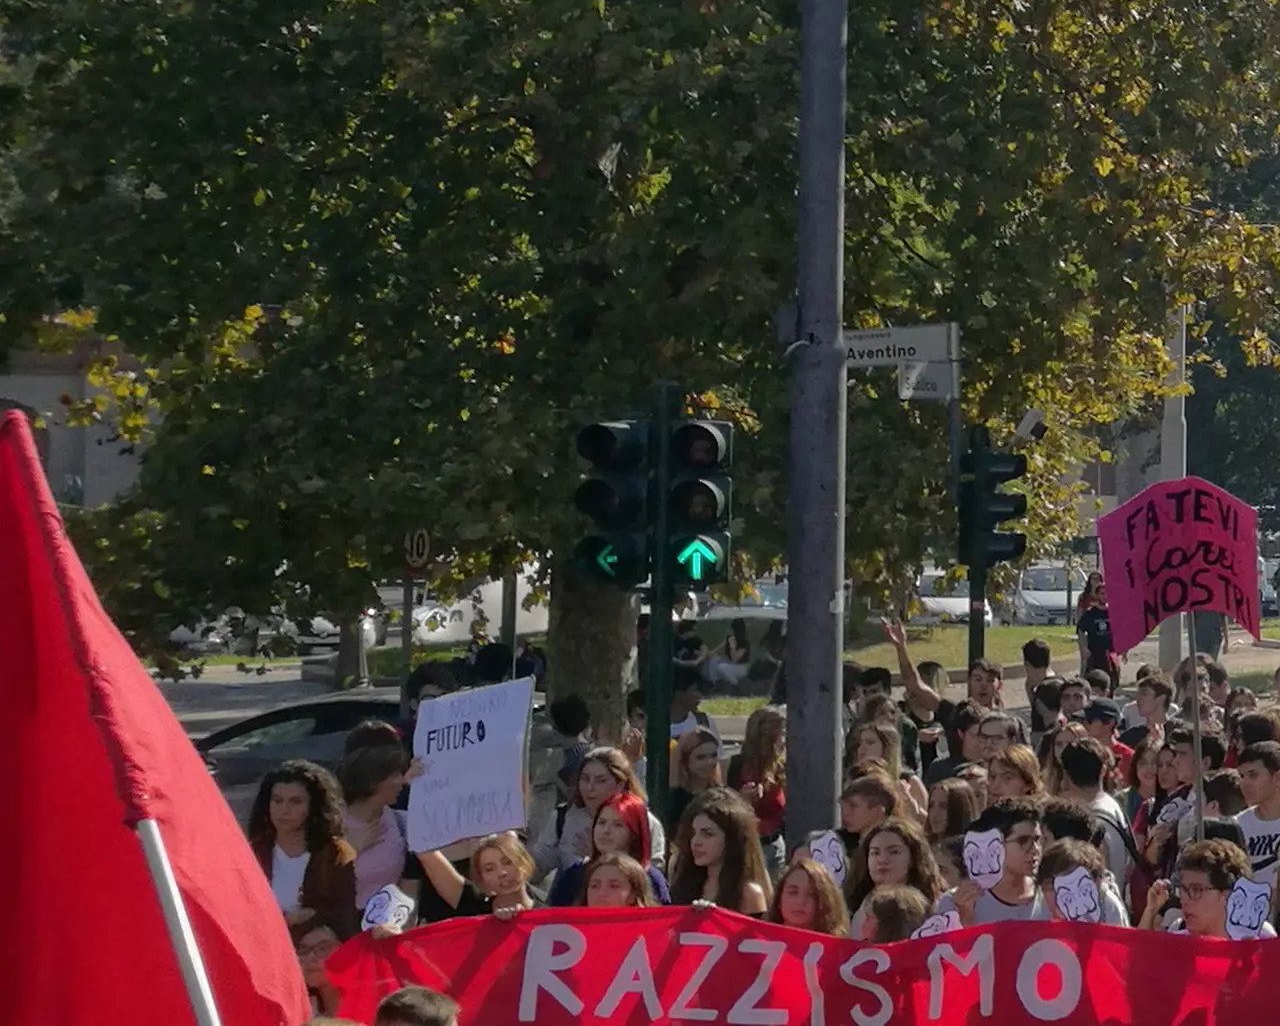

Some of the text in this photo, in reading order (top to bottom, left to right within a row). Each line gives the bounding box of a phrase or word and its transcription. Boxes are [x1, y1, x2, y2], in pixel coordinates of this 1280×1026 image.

[846, 345, 917, 360] Aventino
[1126, 488, 1238, 550] FATEVI
[1143, 568, 1253, 636] NOSTRI
[426, 720, 487, 755] FUTURO
[518, 923, 1082, 1026] RAZZISMO
